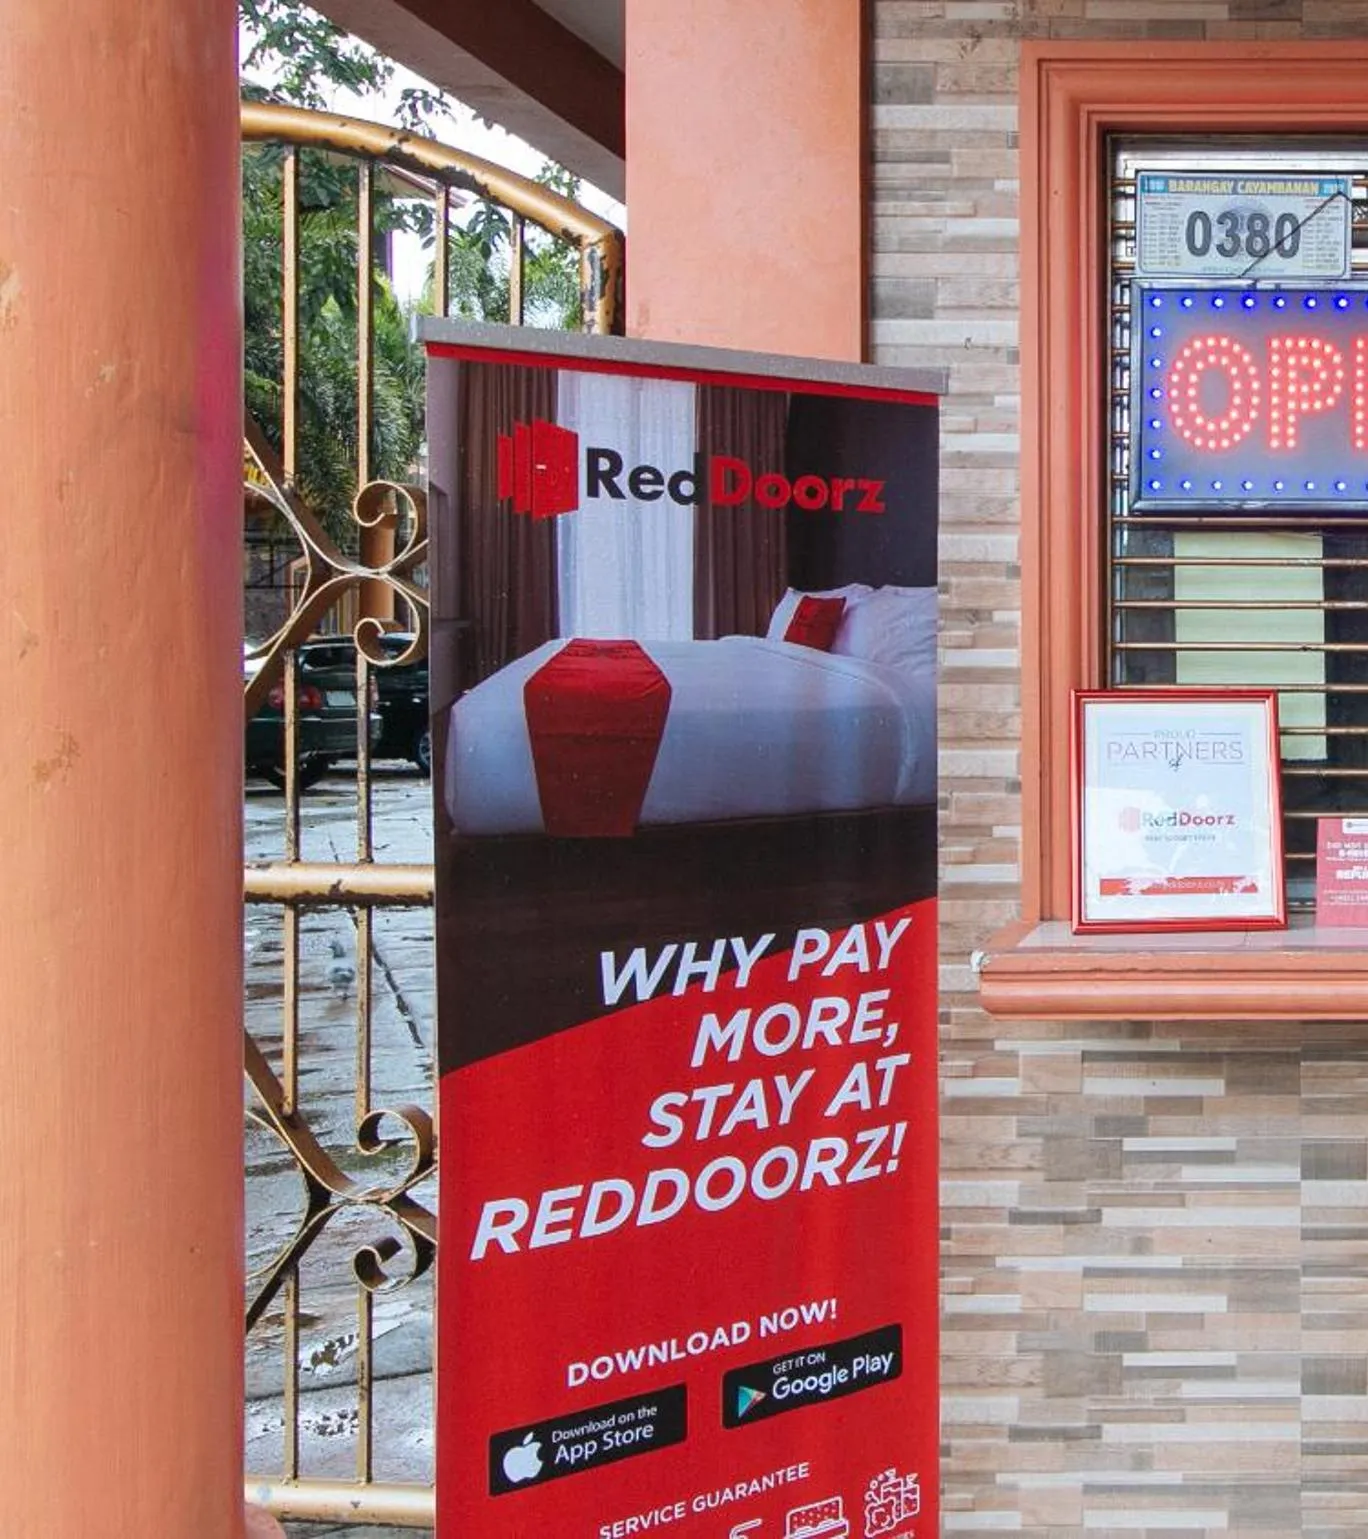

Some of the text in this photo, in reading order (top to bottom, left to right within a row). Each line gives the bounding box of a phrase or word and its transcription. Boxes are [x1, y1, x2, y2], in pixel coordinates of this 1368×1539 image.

[1185, 211, 1302, 259] 0380
[586, 447, 886, 514] RedDoorz
[1106, 741, 1244, 761] PARTNERS
[601, 917, 914, 1006] WHY PAY
[690, 989, 899, 1068] MORE,
[641, 1053, 911, 1149] STAY AT
[470, 1122, 908, 1261] REDDOORZ!
[566, 1298, 838, 1388] DOWNLOAD NOW!
[772, 1351, 827, 1375] GET IT ON
[772, 1351, 895, 1400] Google Play
[551, 1405, 658, 1444] Download on the
[554, 1424, 654, 1466] App Store
[599, 1462, 812, 1539] SERVICE GUARANTEE
